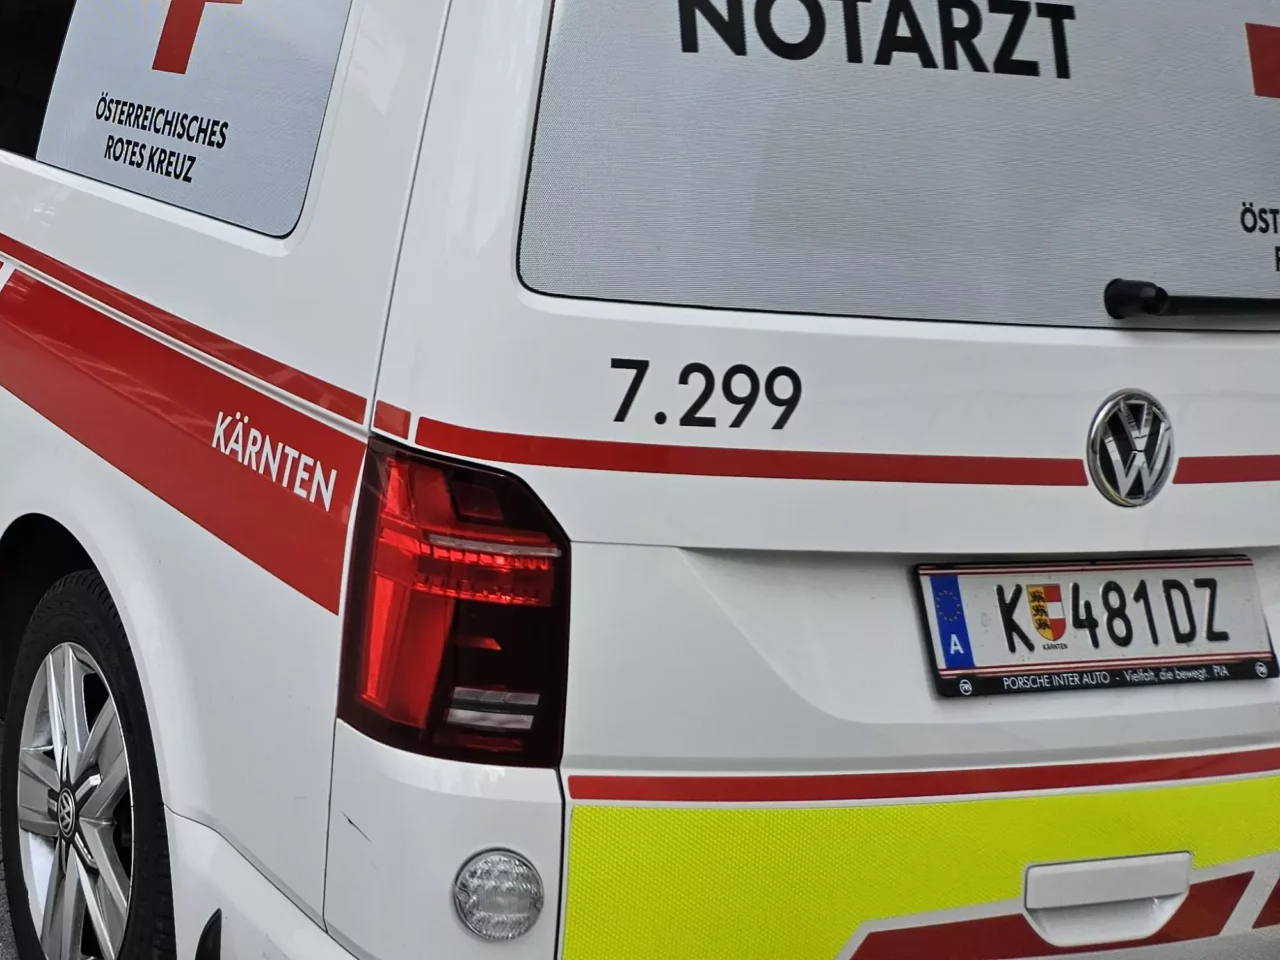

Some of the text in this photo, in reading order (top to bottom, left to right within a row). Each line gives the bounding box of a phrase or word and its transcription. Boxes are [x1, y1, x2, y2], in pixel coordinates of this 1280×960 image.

[95, 92, 229, 150] ÖSTERREICHISCHES
[104, 135, 196, 183] ROTES KREUZ
[610, 357, 802, 430] 7.299
[212, 411, 337, 512] KÄRNTEN
[950, 634, 964, 655] A
[995, 584, 1035, 653] K
[1003, 676, 1051, 690] PORSCHE
[1052, 673, 1085, 686] INTER
[1086, 671, 1110, 685] AUTO
[1123, 669, 1158, 682] Vielfalt,
[1159, 667, 1173, 680] die
